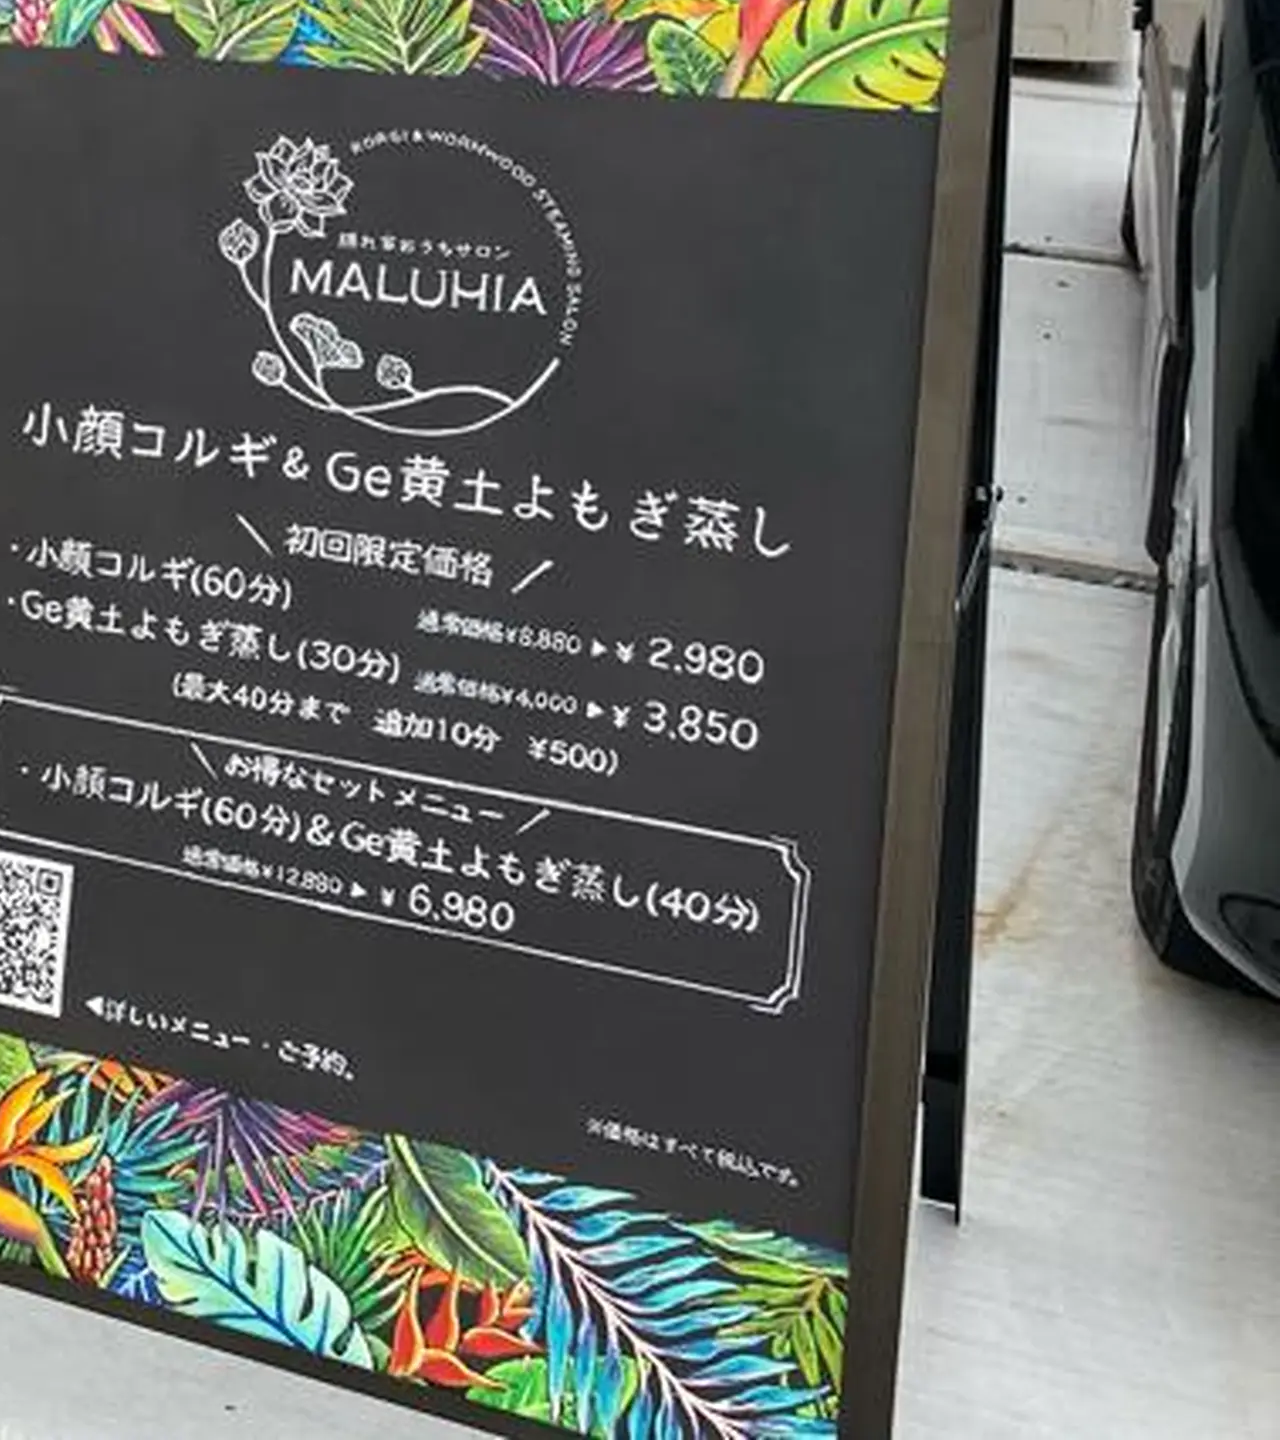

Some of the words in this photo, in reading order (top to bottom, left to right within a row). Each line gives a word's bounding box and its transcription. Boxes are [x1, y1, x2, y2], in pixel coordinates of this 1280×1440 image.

[290, 258, 548, 316] MALUHIA
[283, 522, 494, 588] 初回限定価格
[223, 753, 505, 824] お得なセットメニュー
